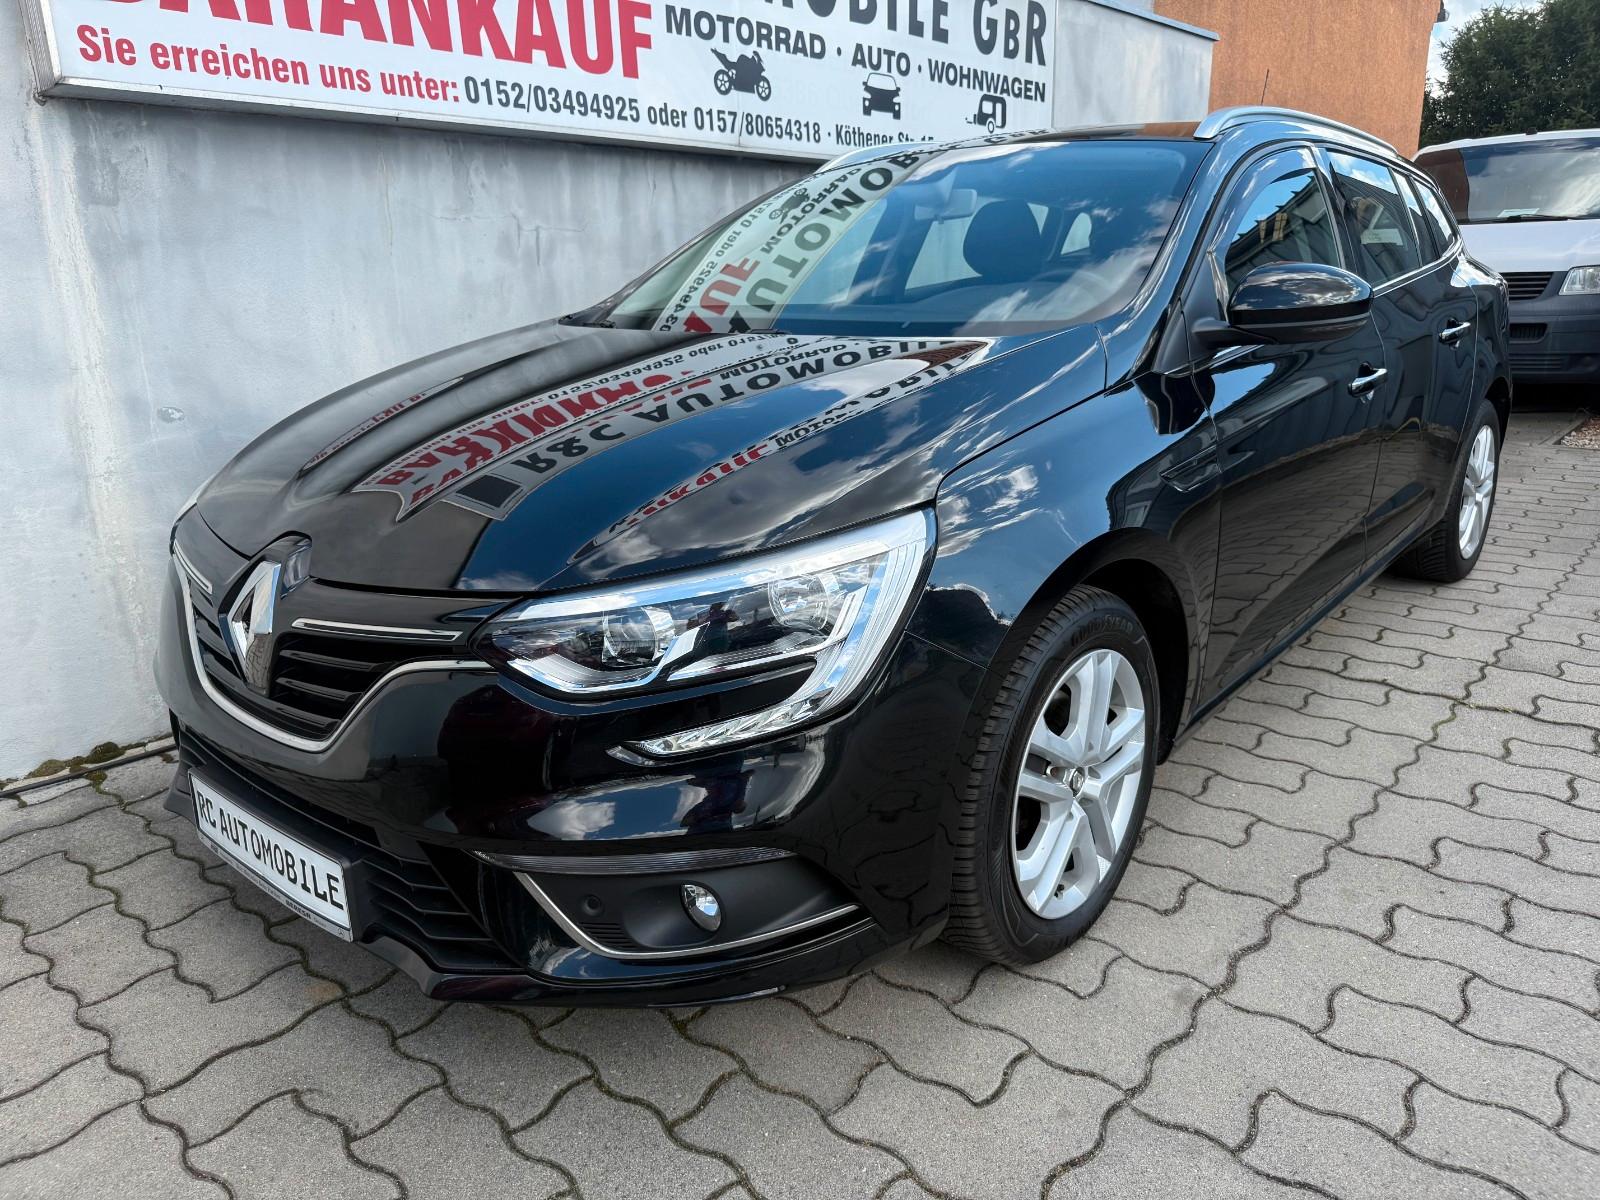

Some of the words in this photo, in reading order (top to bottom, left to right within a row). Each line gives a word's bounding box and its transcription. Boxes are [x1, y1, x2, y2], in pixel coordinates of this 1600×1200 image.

[76, 24, 137, 66] Sie
[150, 41, 309, 85] erreichen
[319, 63, 371, 93] uns
[379, 70, 459, 103] unter:
[464, 76, 640, 123] 0152/03494925
[647, 102, 687, 129] oder
[694, 107, 821, 144] 0157/80654318
[836, 124, 893, 148] Köthener
[665, 4, 826, 60] MOTORRAD
[851, 43, 911, 77] AUTO
[928, 58, 1046, 103] WOHNWAGEN
[196, 790, 217, 829] RC
[218, 808, 344, 911] AUTOMOBILE
